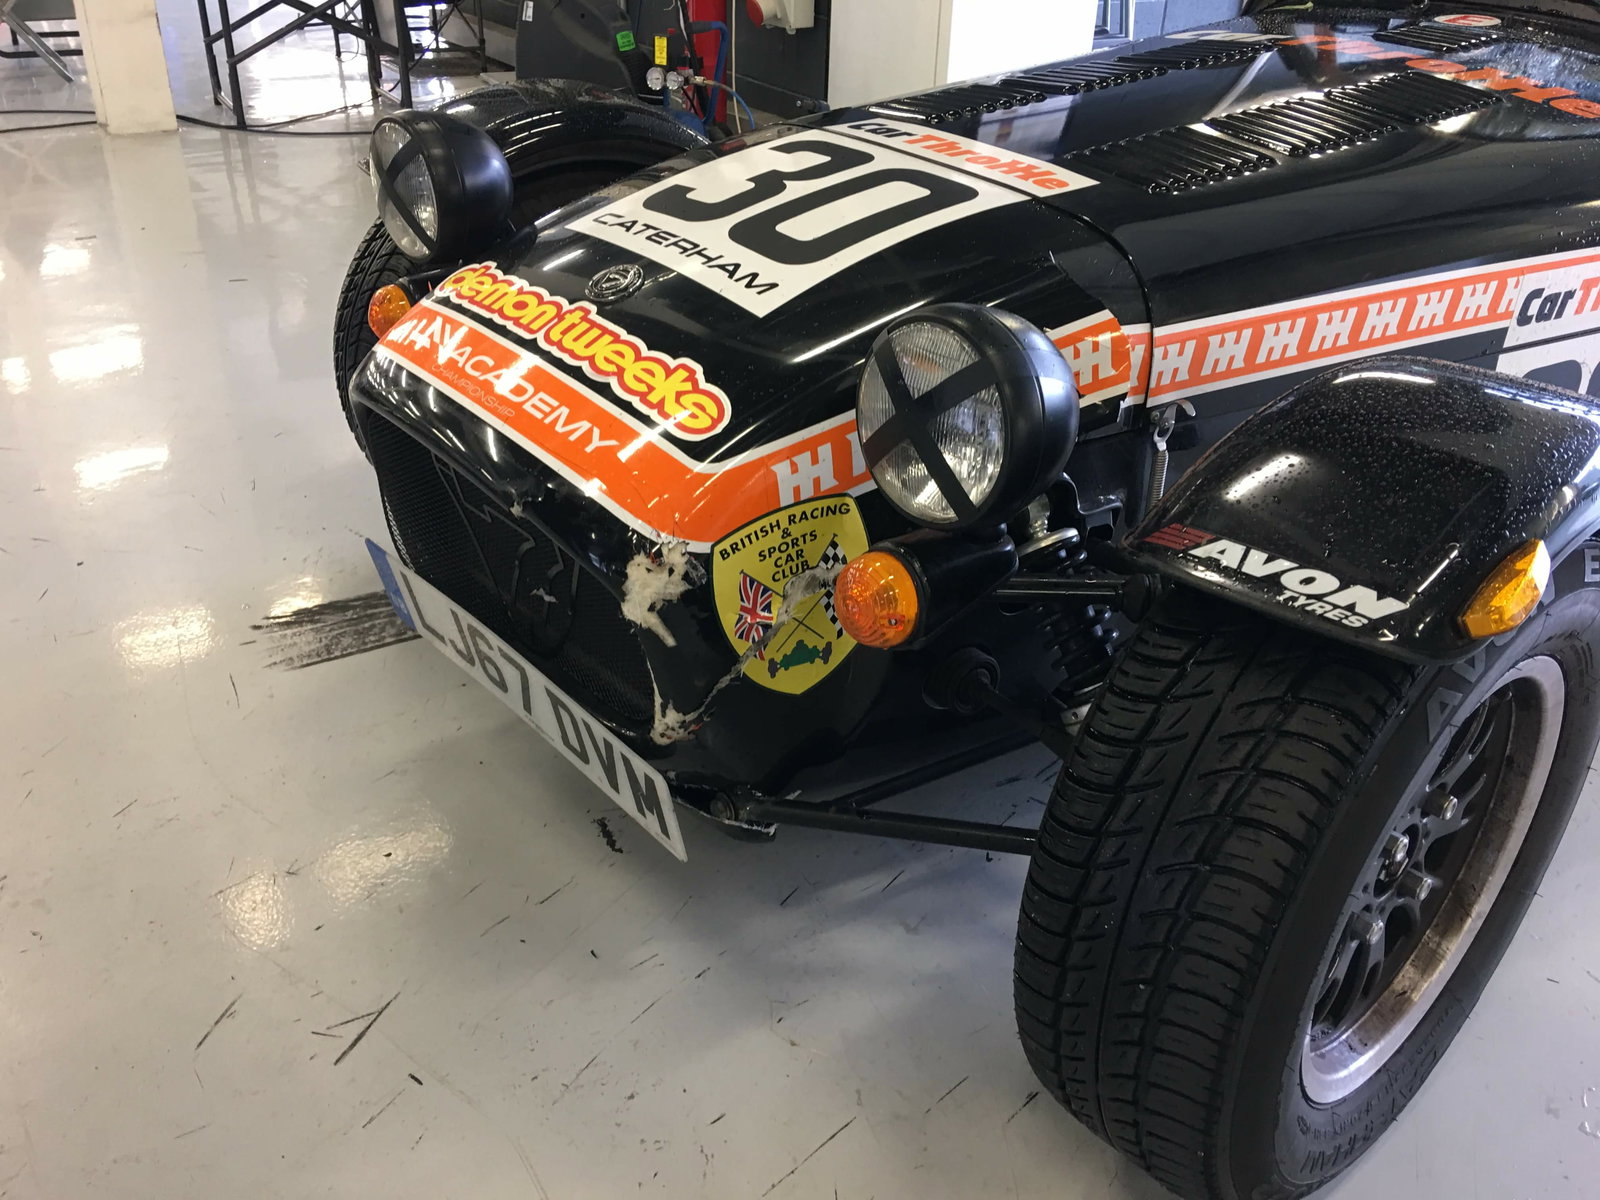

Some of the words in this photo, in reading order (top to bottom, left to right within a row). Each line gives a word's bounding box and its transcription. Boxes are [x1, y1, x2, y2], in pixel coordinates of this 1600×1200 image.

[642, 140, 979, 265] 30
[592, 212, 779, 296] CATERHAM
[444, 265, 558, 332] demon
[549, 309, 719, 430] tweeks
[431, 363, 516, 418] CHAMPIONSHIP
[450, 345, 620, 455] ACADEMY
[719, 519, 781, 561] BRITISH
[788, 502, 851, 527] RACING
[758, 529, 818, 562] SPORTS
[774, 548, 805, 569] CAR
[781, 527, 792, 540] &
[771, 559, 810, 583] CLUB
[1186, 539, 1409, 620] AVON
[1276, 589, 1369, 628] TYRES
[400, 571, 533, 717] LJ67
[544, 685, 671, 841] DVM
